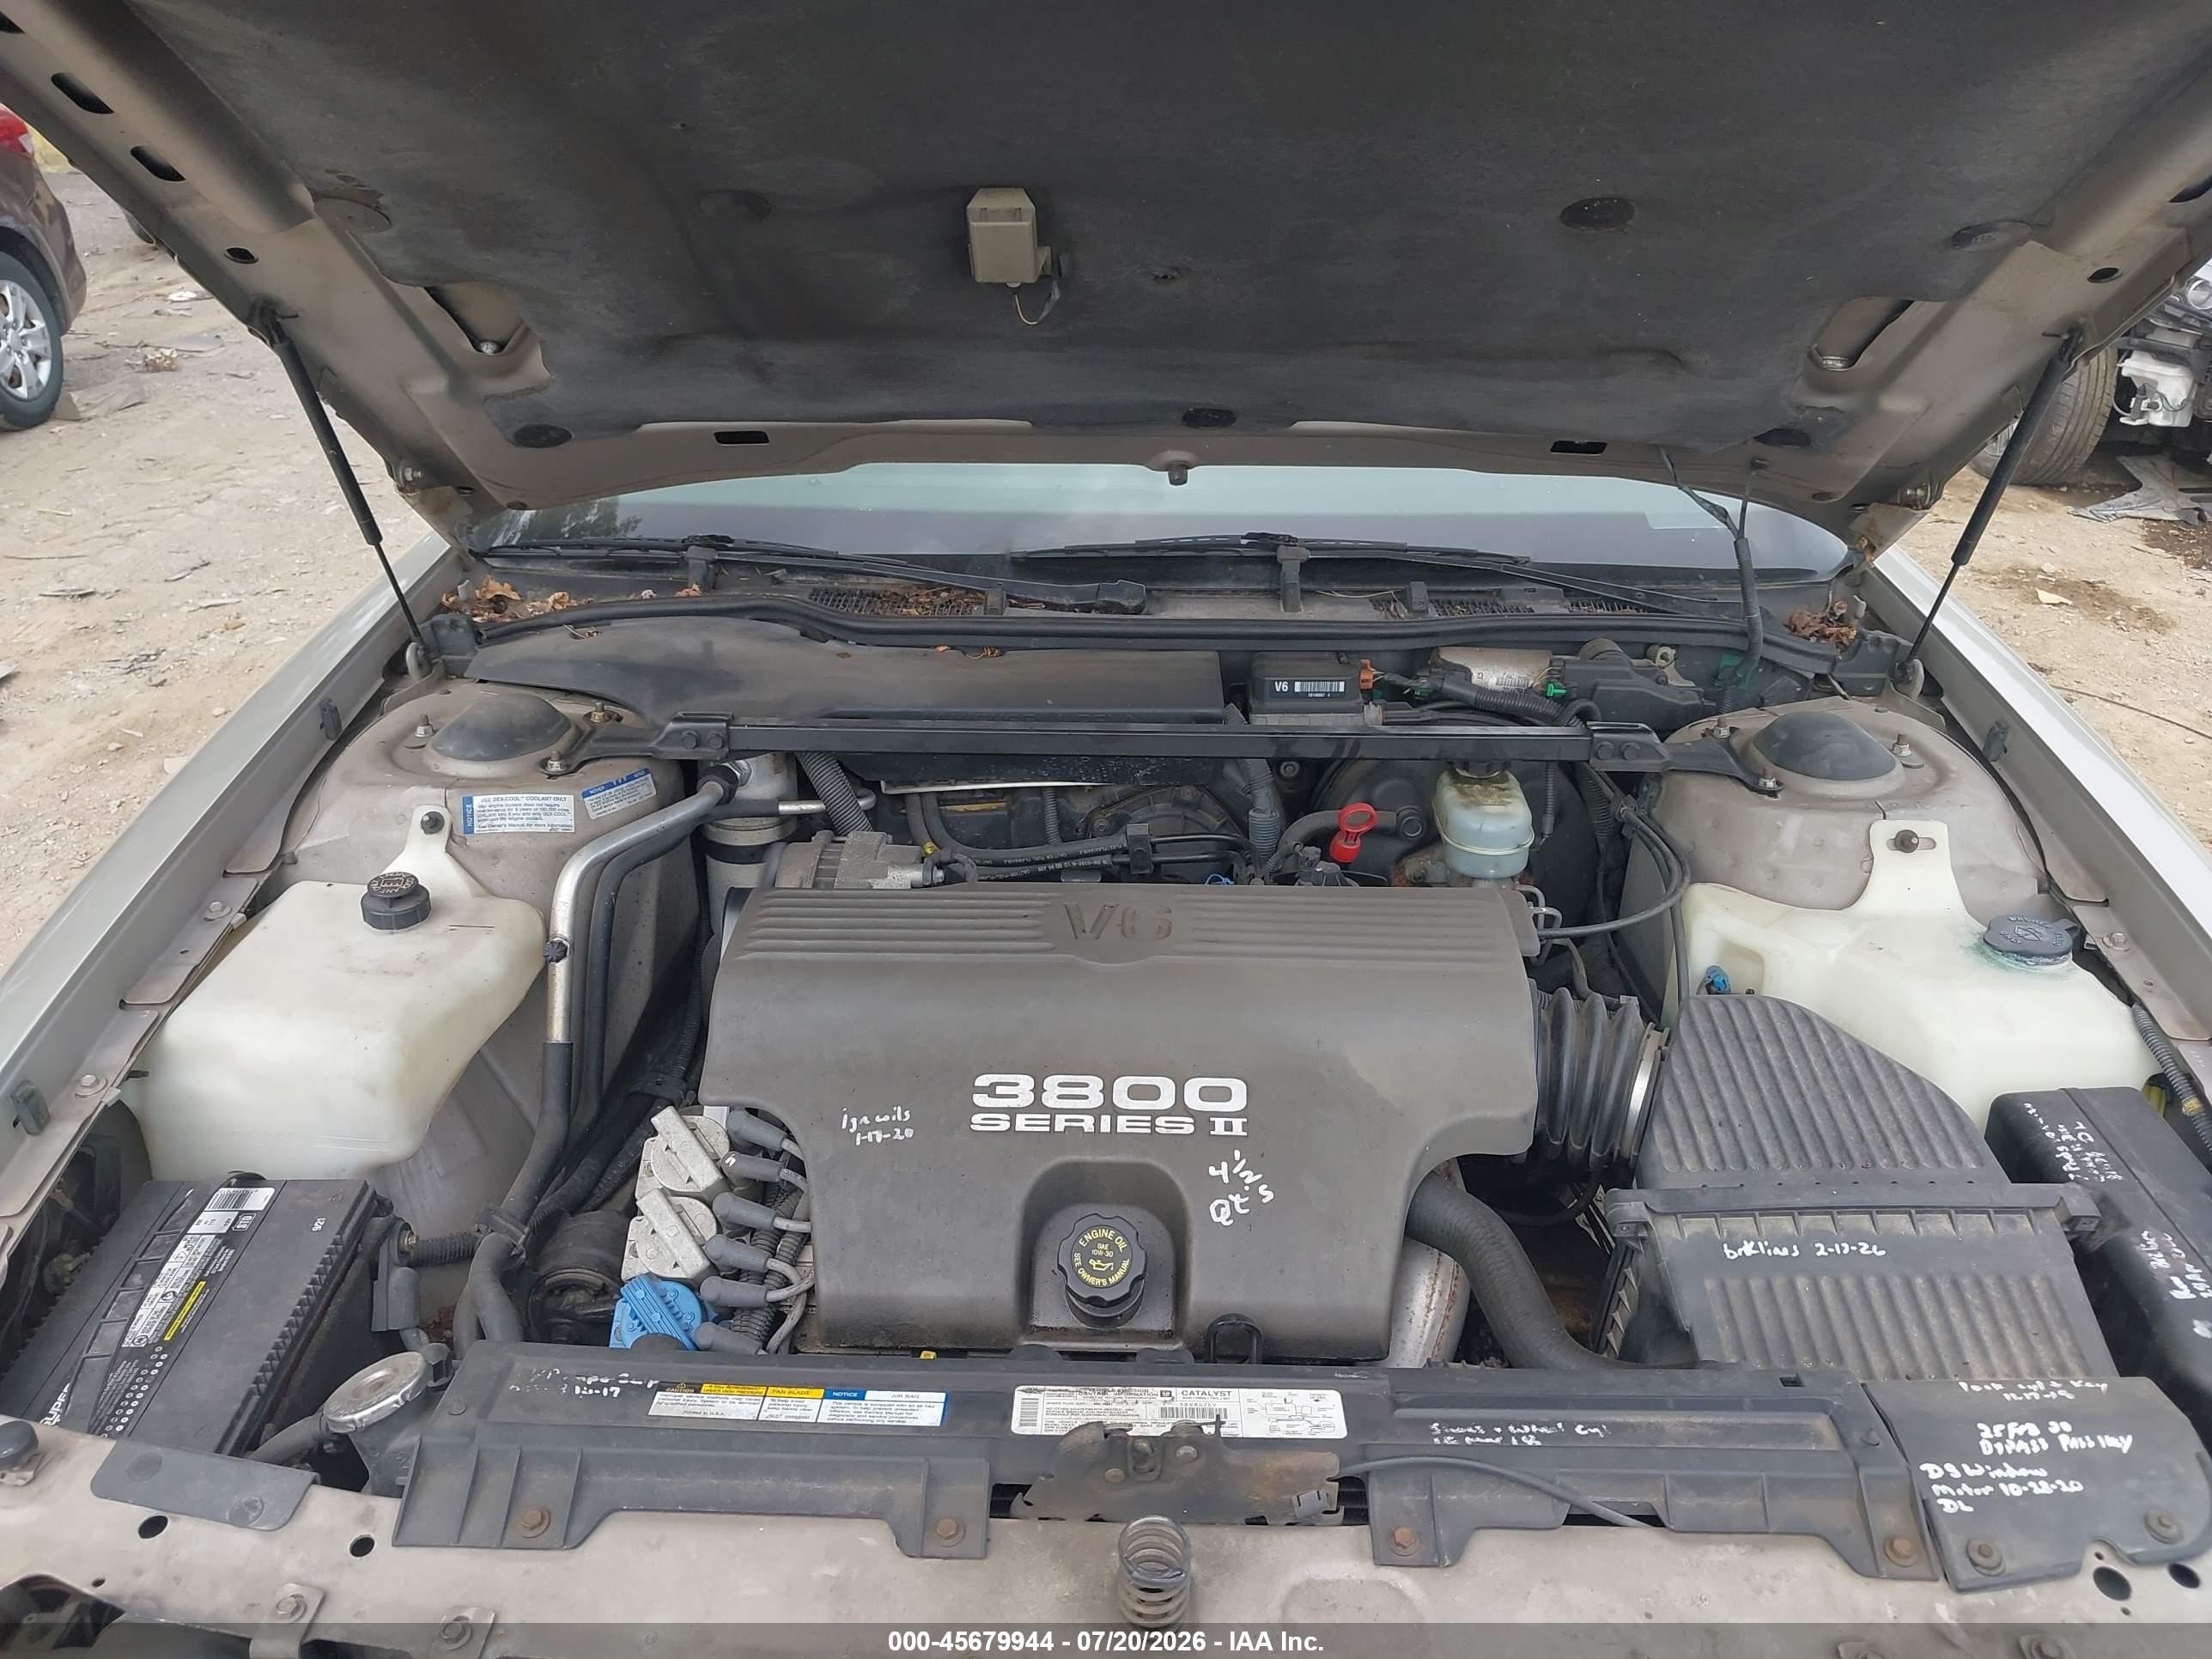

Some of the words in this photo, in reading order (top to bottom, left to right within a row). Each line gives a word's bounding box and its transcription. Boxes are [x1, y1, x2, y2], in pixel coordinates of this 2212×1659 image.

[1273, 681, 1288, 692] V6
[1063, 902, 1173, 941] V6
[972, 1073, 1249, 1113] 3800
[969, 1113, 1195, 1135] SERIES
[1208, 1116, 1249, 1137] II
[311, 1217, 327, 1232] 9/21
[1079, 1228, 1115, 1248] ENGINE
[1115, 1236, 1128, 1253] OIL
[1091, 1249, 1114, 1258] 10W-30
[1073, 1252, 1083, 1268] SEE
[1078, 1267, 1108, 1286] OWNER'S
[1108, 1258, 1130, 1285] MANUAL
